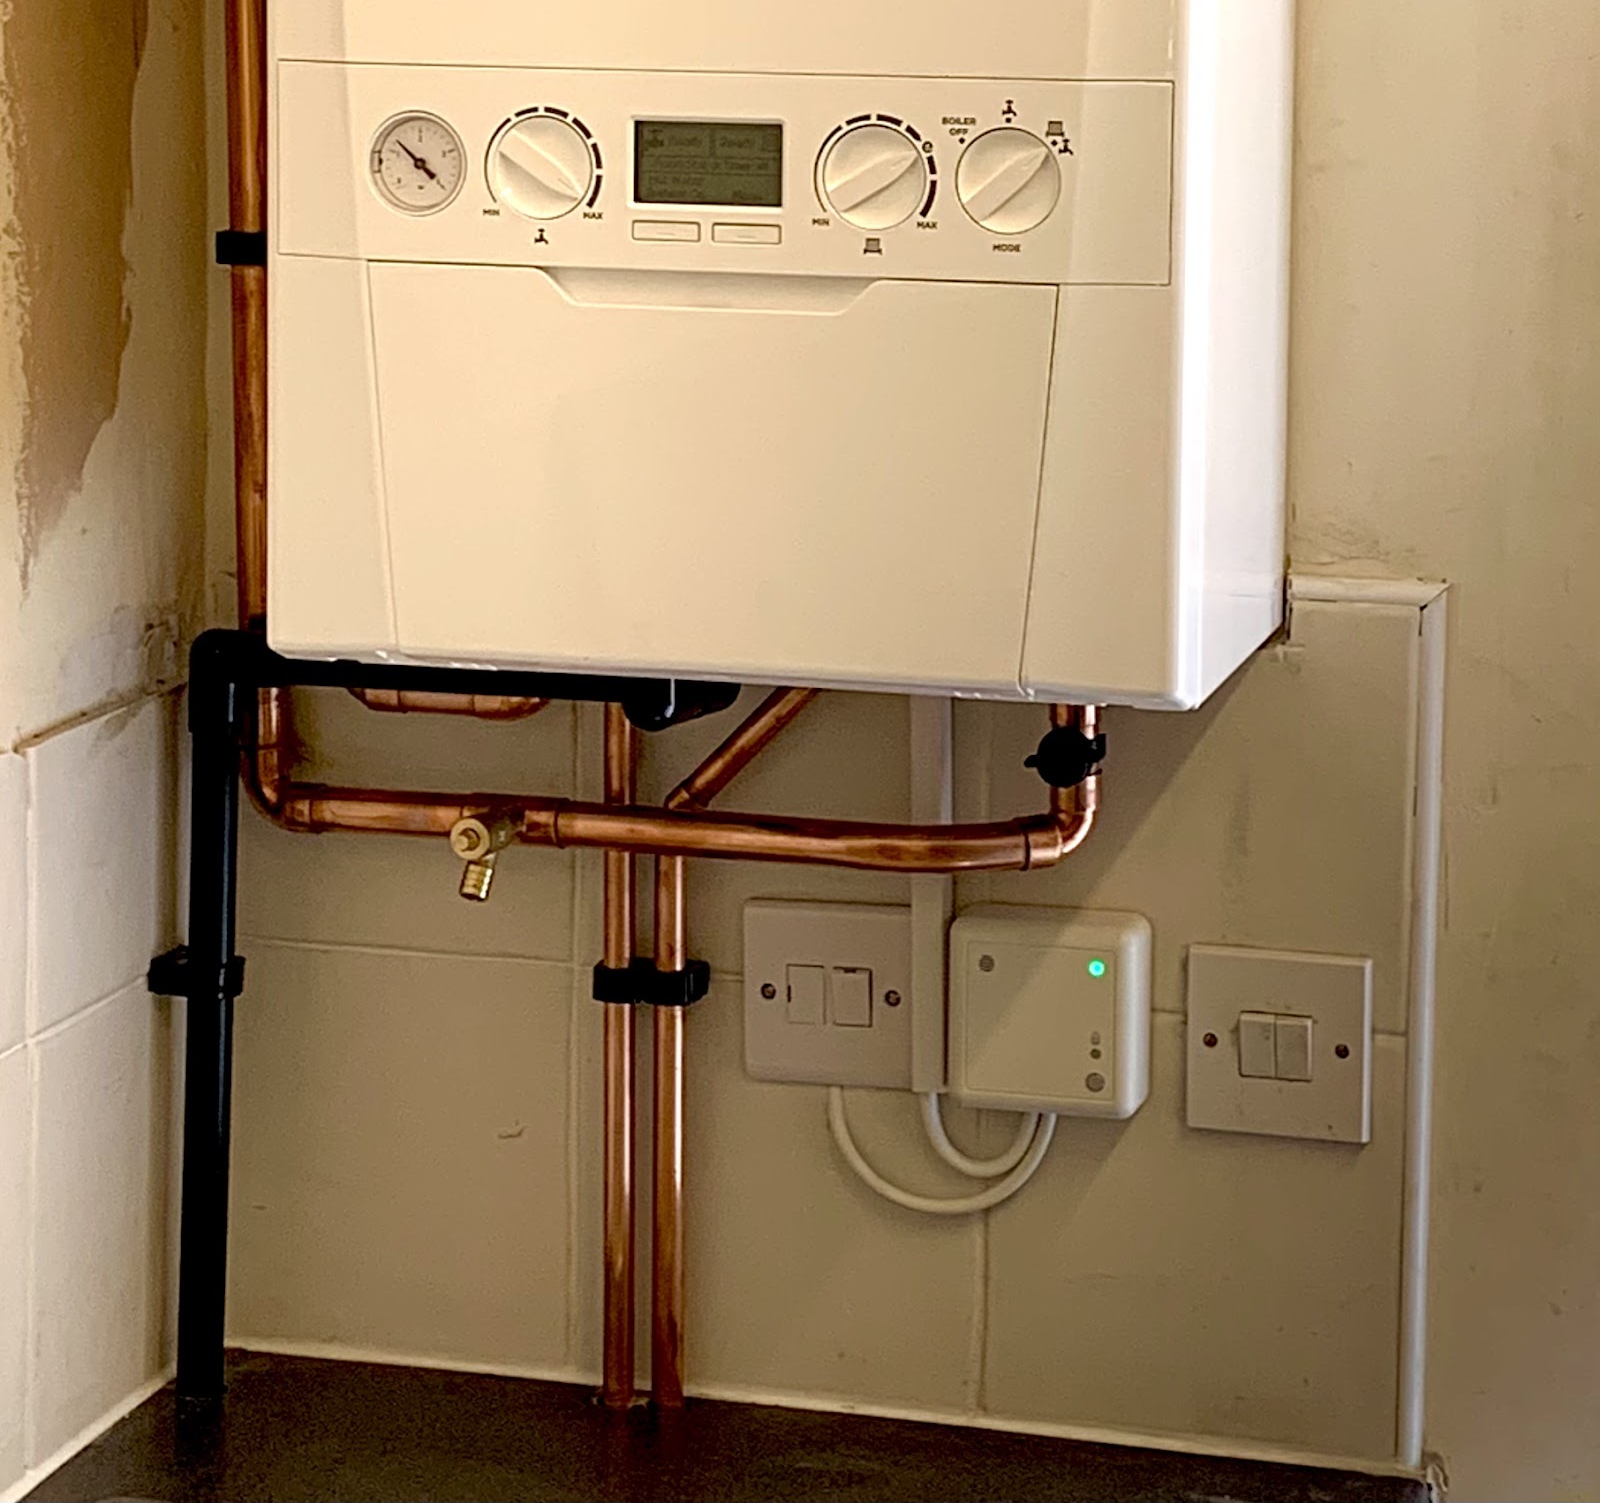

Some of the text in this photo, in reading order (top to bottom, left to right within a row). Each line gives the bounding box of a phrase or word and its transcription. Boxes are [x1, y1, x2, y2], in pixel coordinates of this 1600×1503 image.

[941, 116, 977, 126] BOILER
[948, 127, 969, 137] OFF
[482, 208, 500, 217] MIN
[582, 211, 604, 220] MAX
[811, 217, 830, 227] MIN
[916, 220, 938, 230] MAX
[992, 243, 1022, 253] MODE
